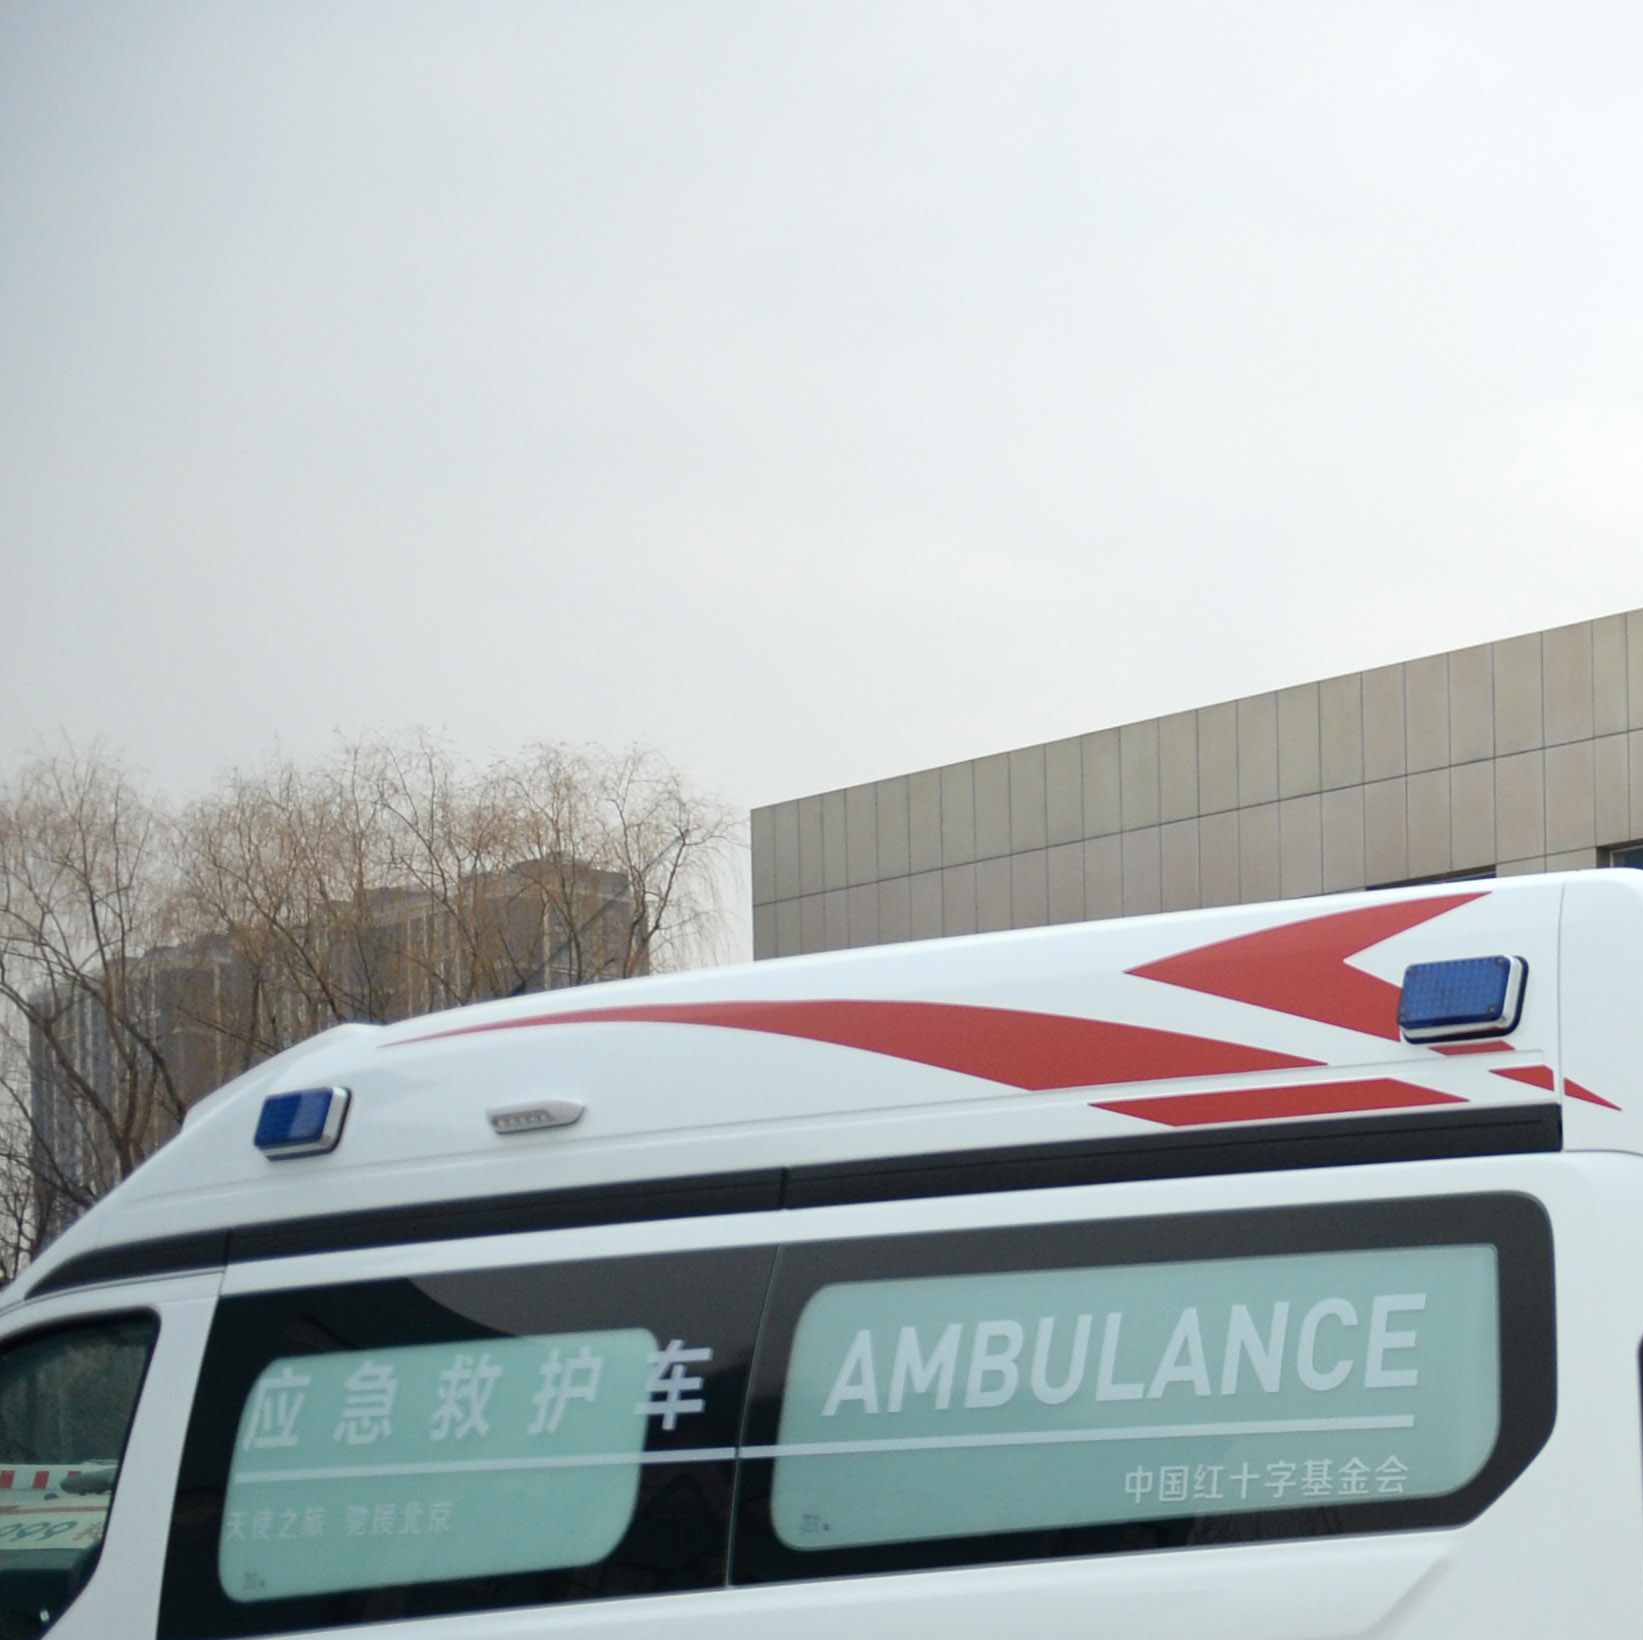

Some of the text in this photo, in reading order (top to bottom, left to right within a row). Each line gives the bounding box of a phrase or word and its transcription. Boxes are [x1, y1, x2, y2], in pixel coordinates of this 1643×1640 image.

[242, 1338, 713, 1452] 应急救护车
[823, 1292, 1428, 1418] AMBULANCE
[1123, 1454, 1411, 1504] 中国红十字基金会
